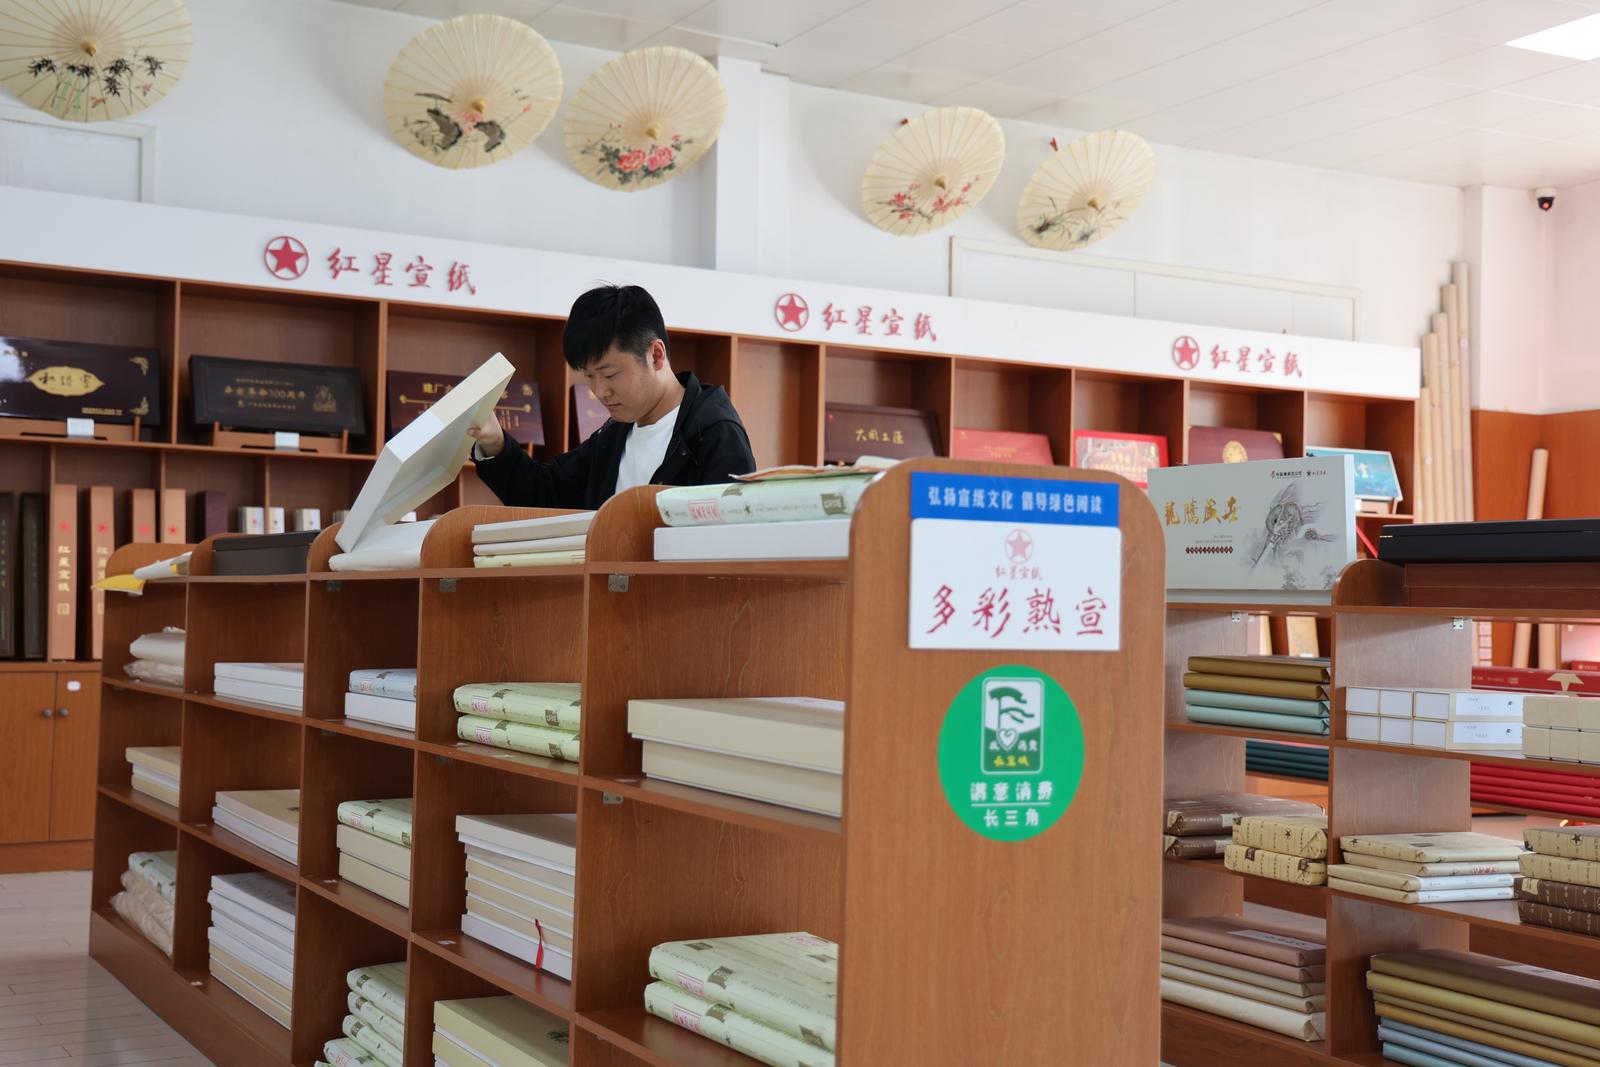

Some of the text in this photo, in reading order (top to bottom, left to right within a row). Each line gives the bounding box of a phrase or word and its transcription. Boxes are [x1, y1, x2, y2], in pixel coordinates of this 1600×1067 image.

[326, 247, 476, 295] 红星宣纸
[821, 302, 938, 343] 红星宣纸
[1211, 344, 1303, 378] 红星宣纸
[928, 486, 1103, 514] 弘扬宣纸文化 倡导绿色阅读
[995, 565, 1043, 581] 红星宣纸
[926, 584, 1107, 639] 多彩熟宣
[969, 780, 1053, 802] 满意消费
[984, 808, 1040, 828] 长三角
